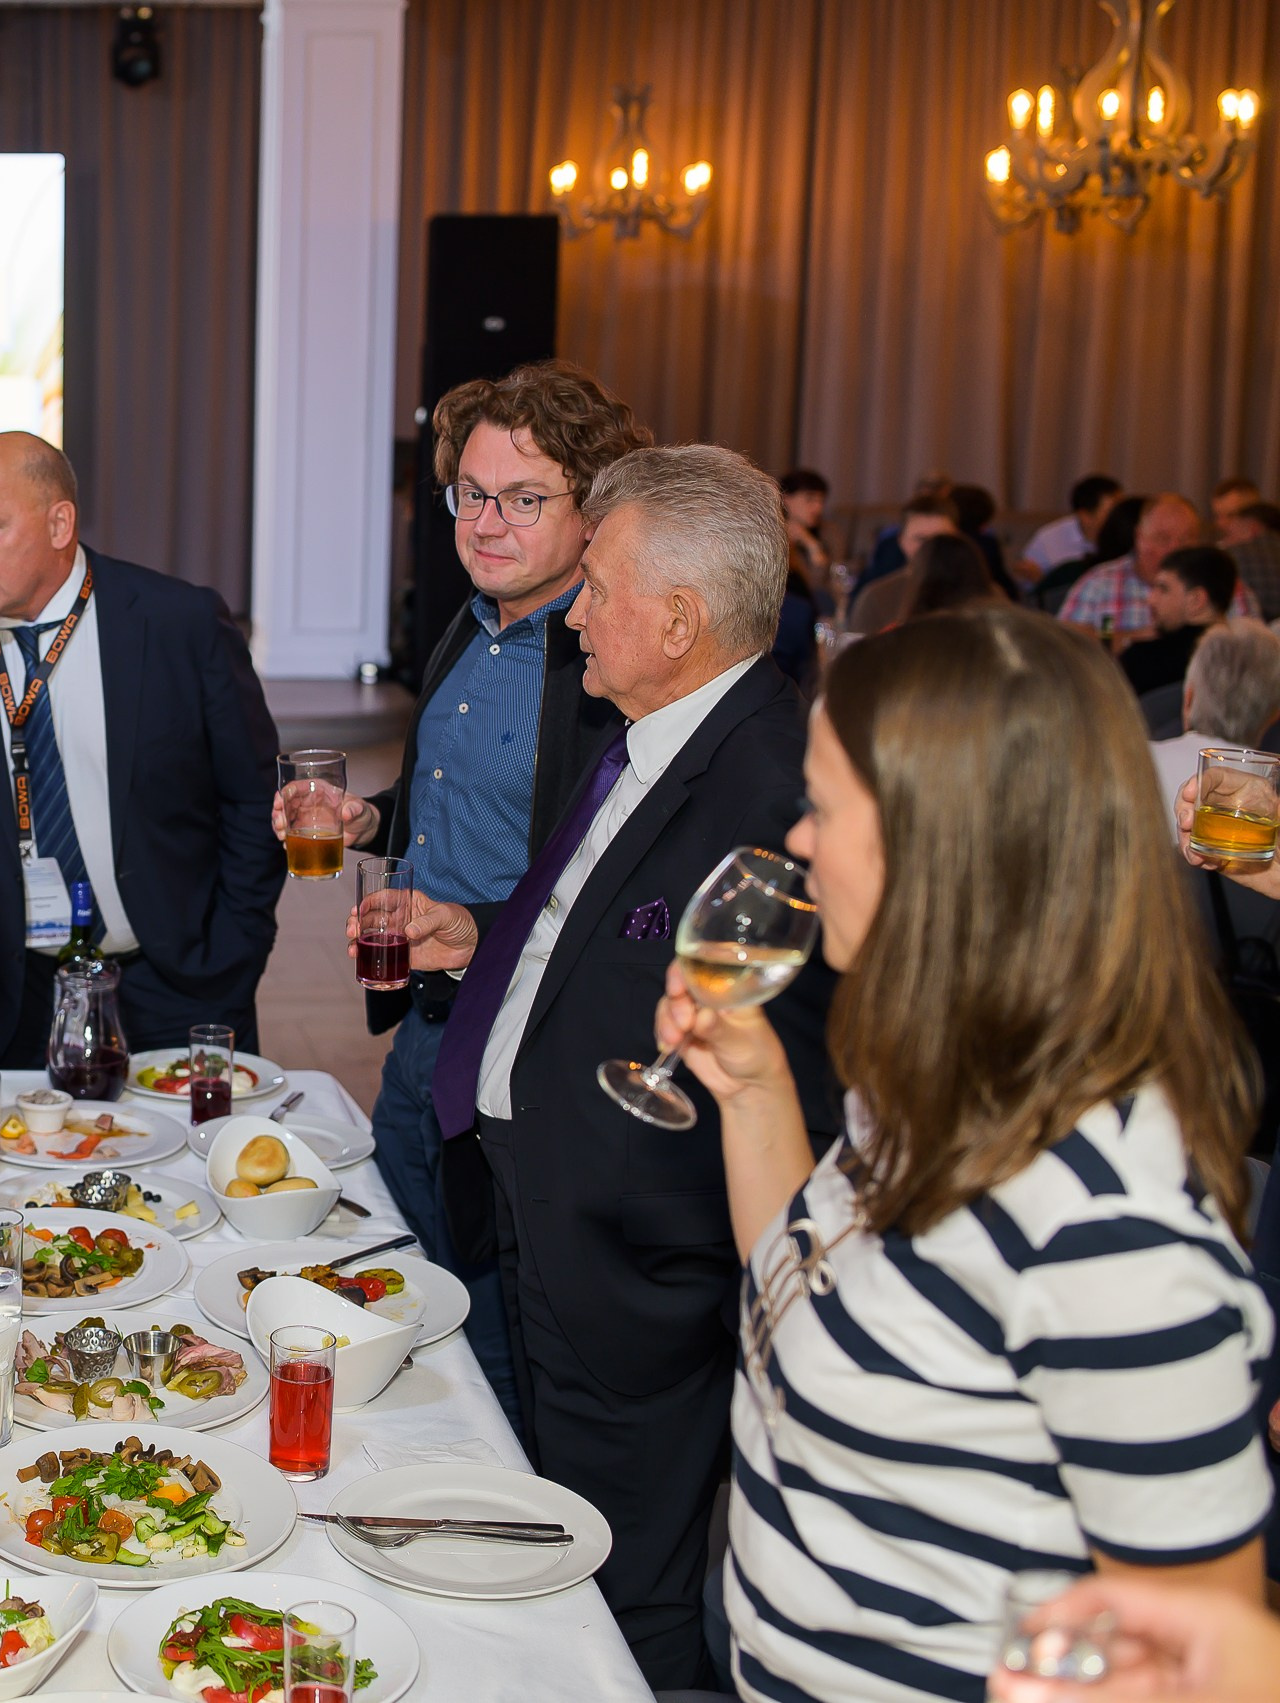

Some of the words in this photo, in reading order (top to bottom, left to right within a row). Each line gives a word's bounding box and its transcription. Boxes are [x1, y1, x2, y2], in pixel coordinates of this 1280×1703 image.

[45, 613, 78, 664] BOWA
[13, 678, 43, 727] BOWA
[16, 775, 30, 830] BOWA
